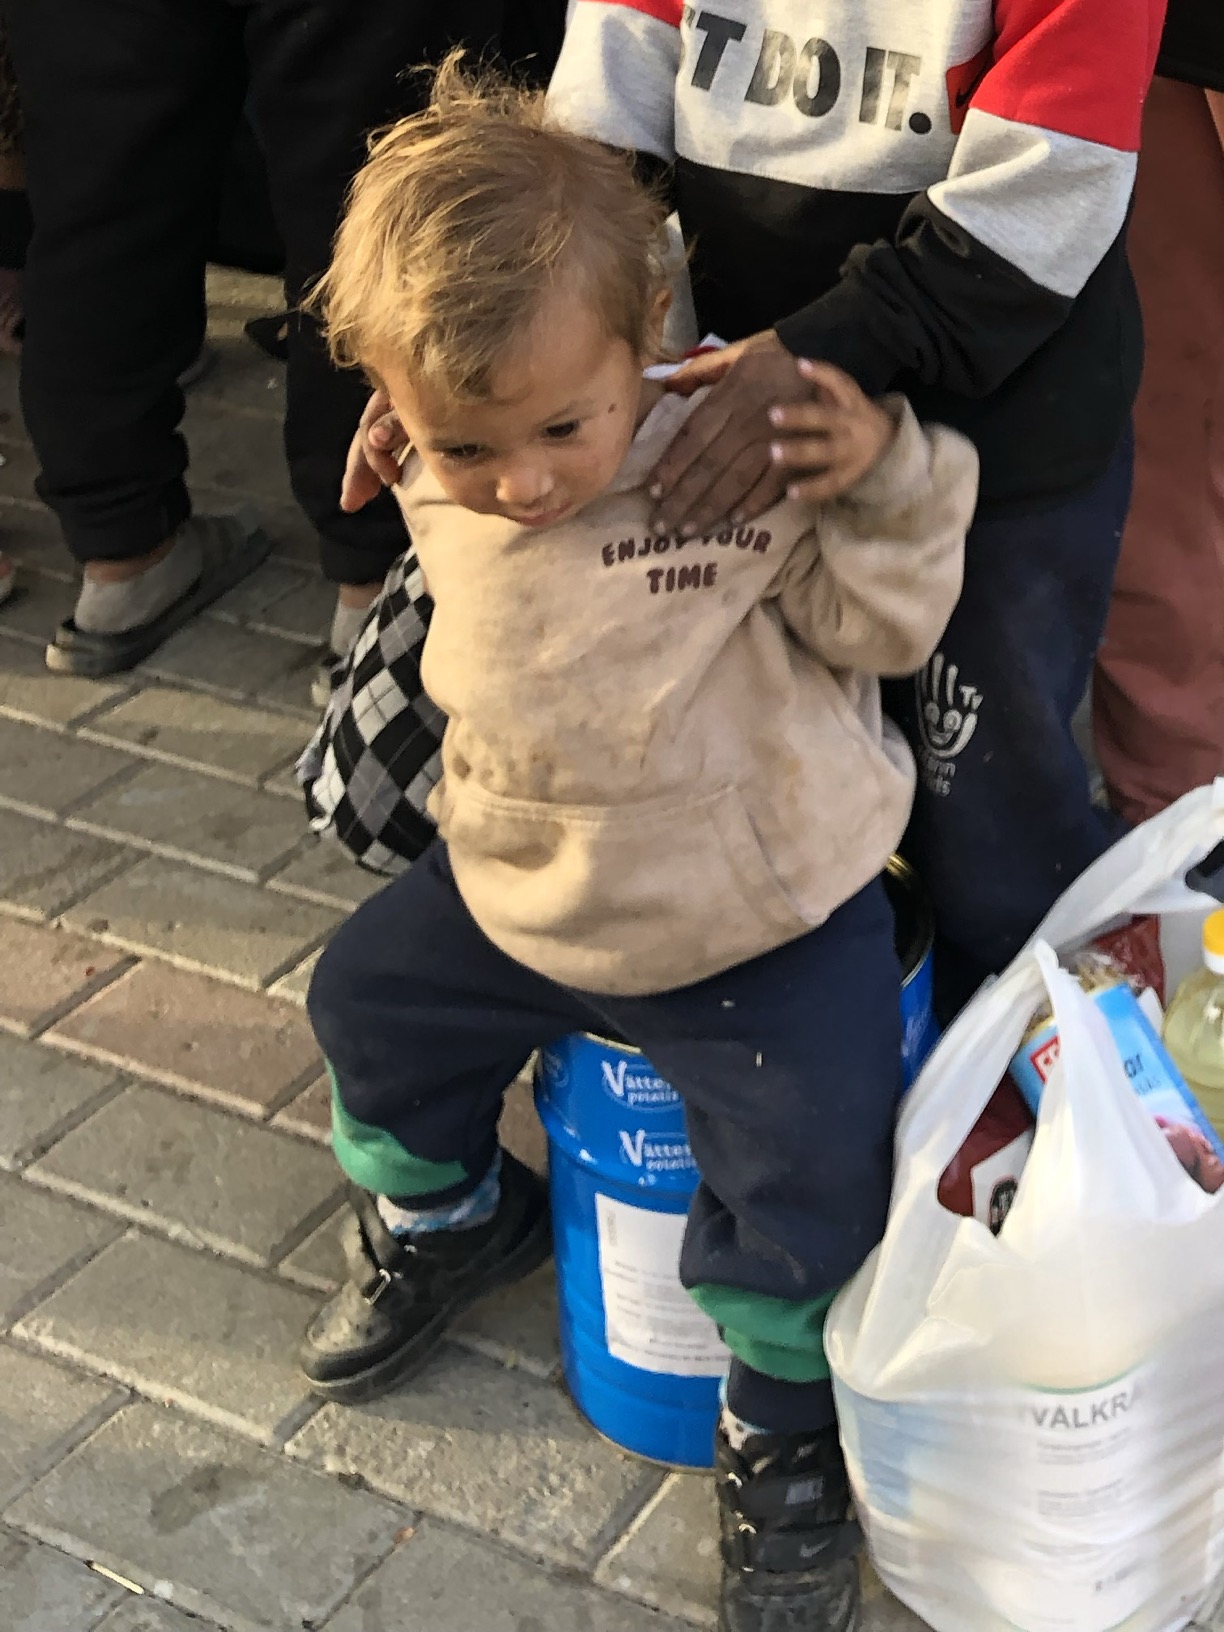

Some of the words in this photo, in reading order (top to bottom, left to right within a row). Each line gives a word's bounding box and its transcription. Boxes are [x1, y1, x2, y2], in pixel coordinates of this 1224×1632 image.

[681, 5, 748, 92] T
[744, 28, 841, 118] DO
[858, 45, 932, 136] IT.
[646, 562, 718, 595] TIME
